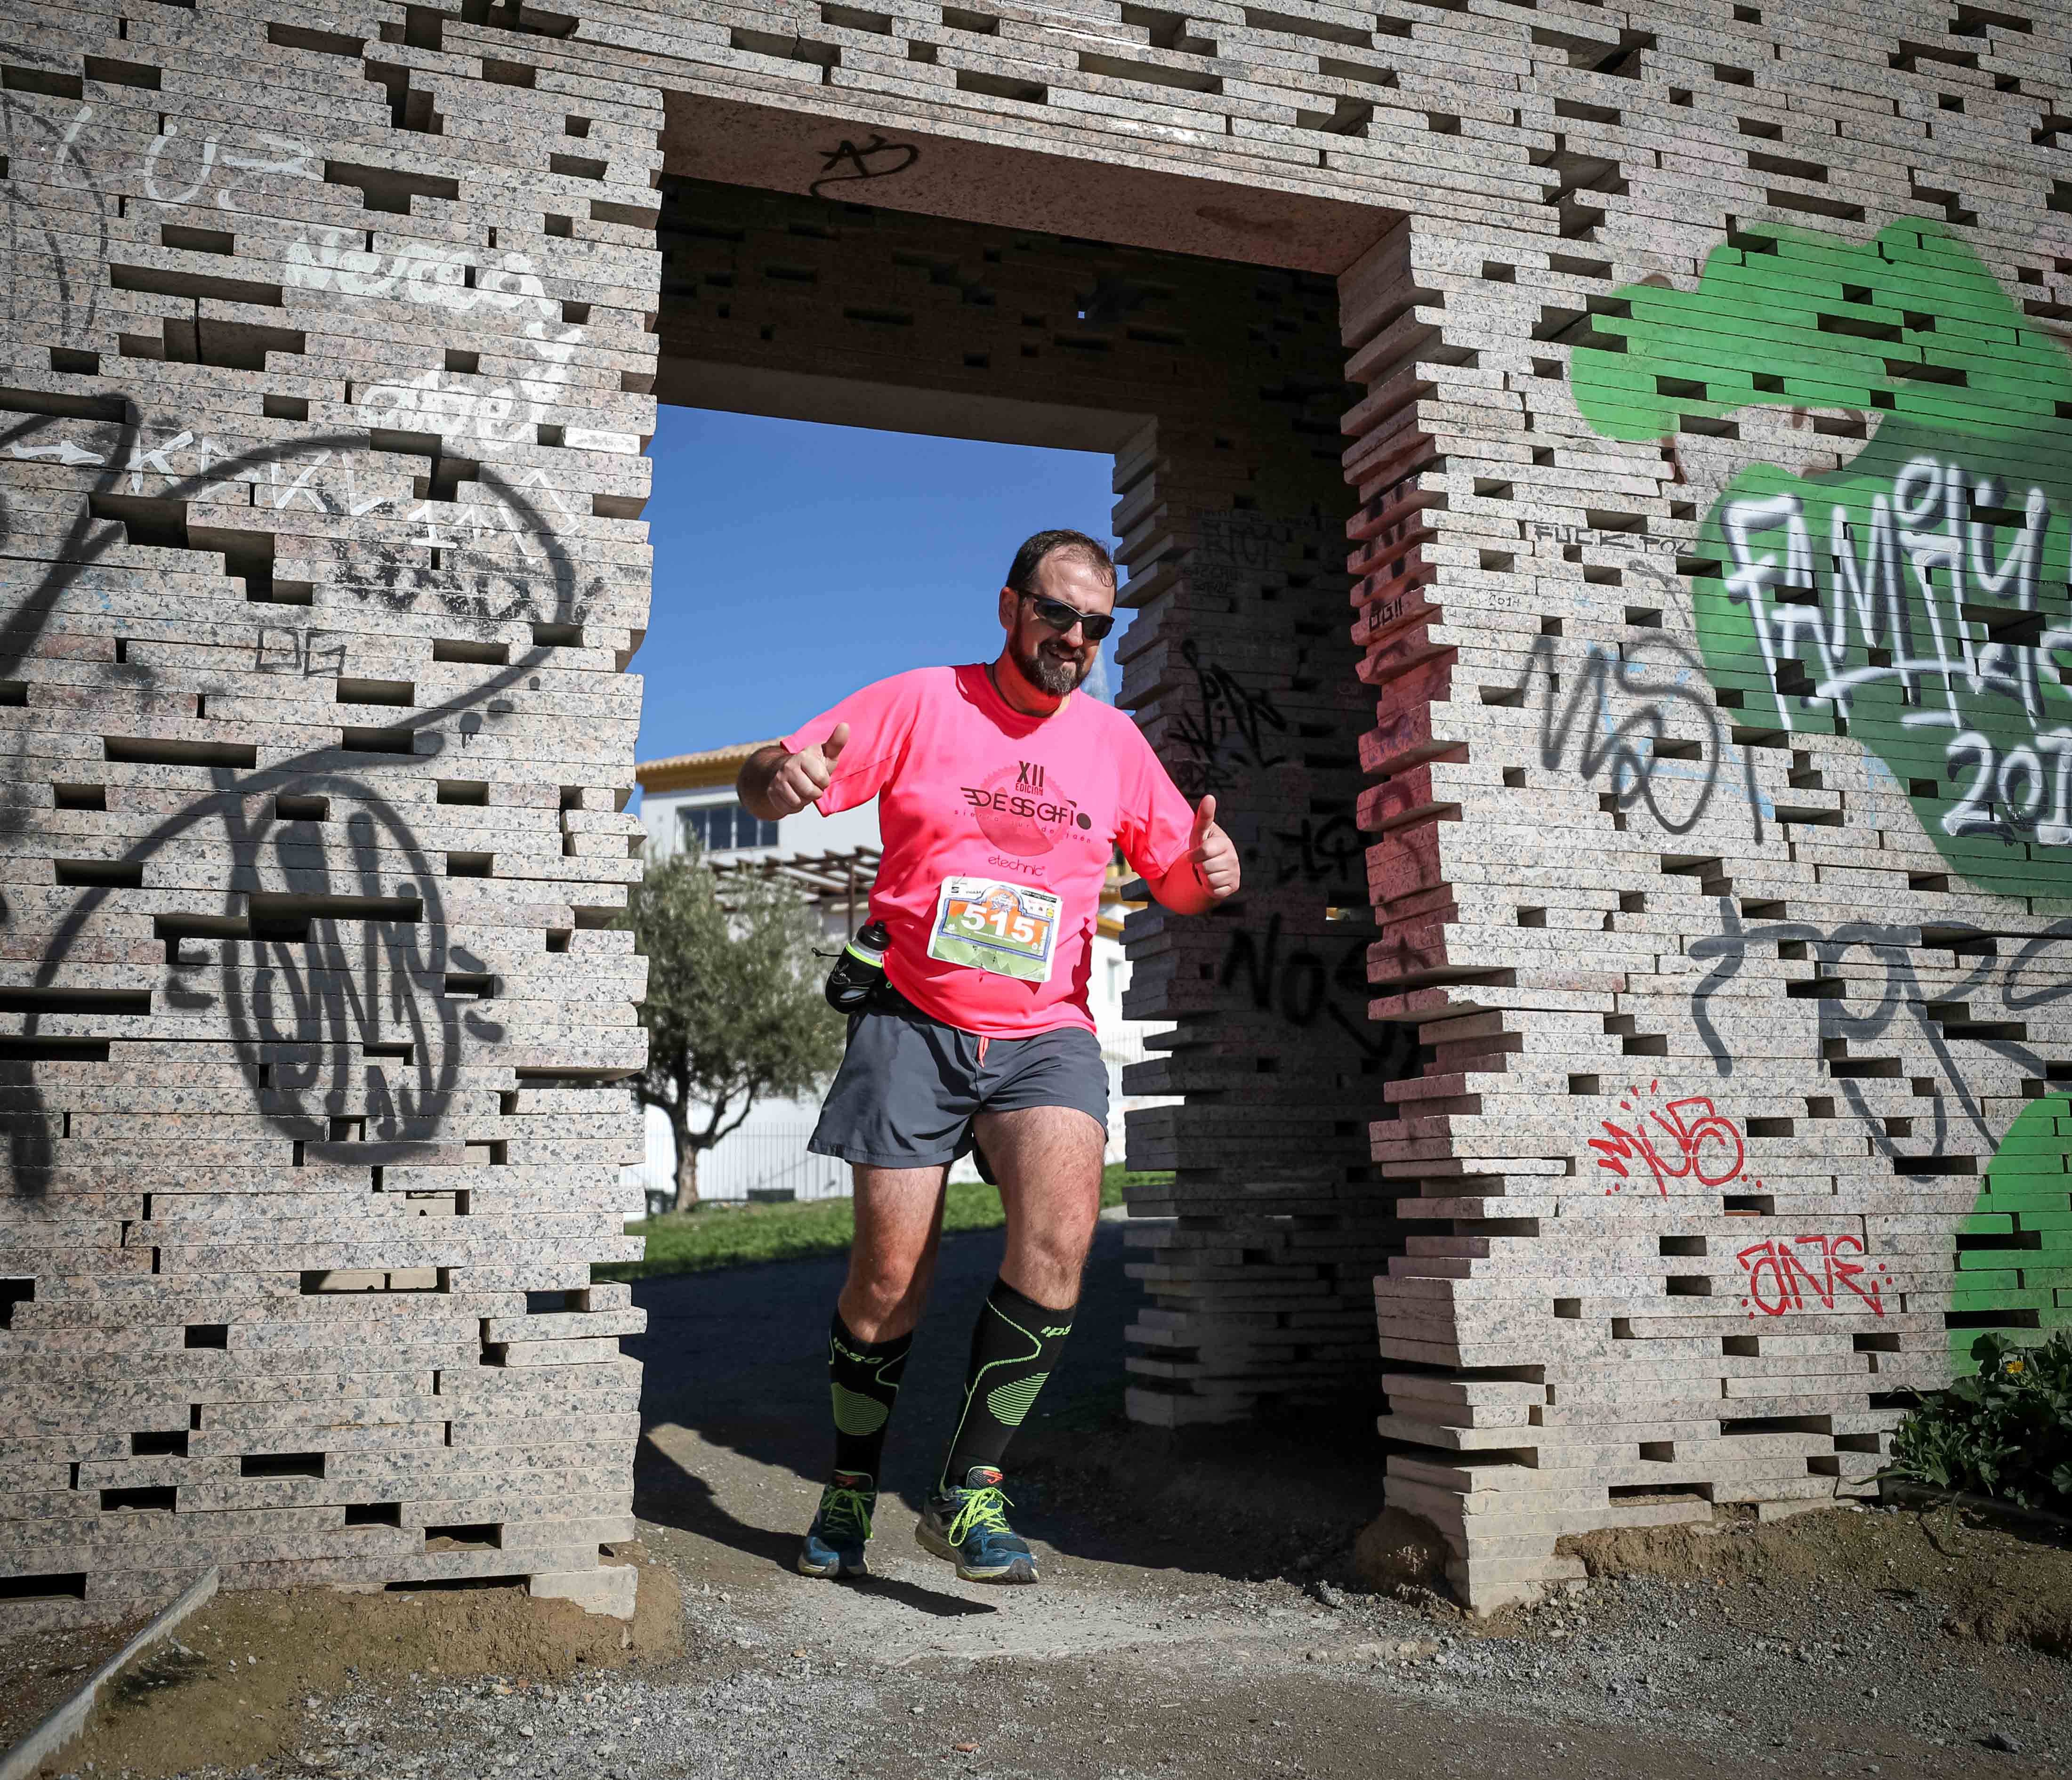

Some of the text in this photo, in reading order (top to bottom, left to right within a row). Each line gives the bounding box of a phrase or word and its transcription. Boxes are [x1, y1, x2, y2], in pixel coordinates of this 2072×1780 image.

[1534, 524, 1634, 549] FUCK
[1016, 760, 1044, 787] XII
[954, 809, 999, 822] sierra
[1041, 826, 1055, 834] de
[960, 903, 1035, 942] 515
